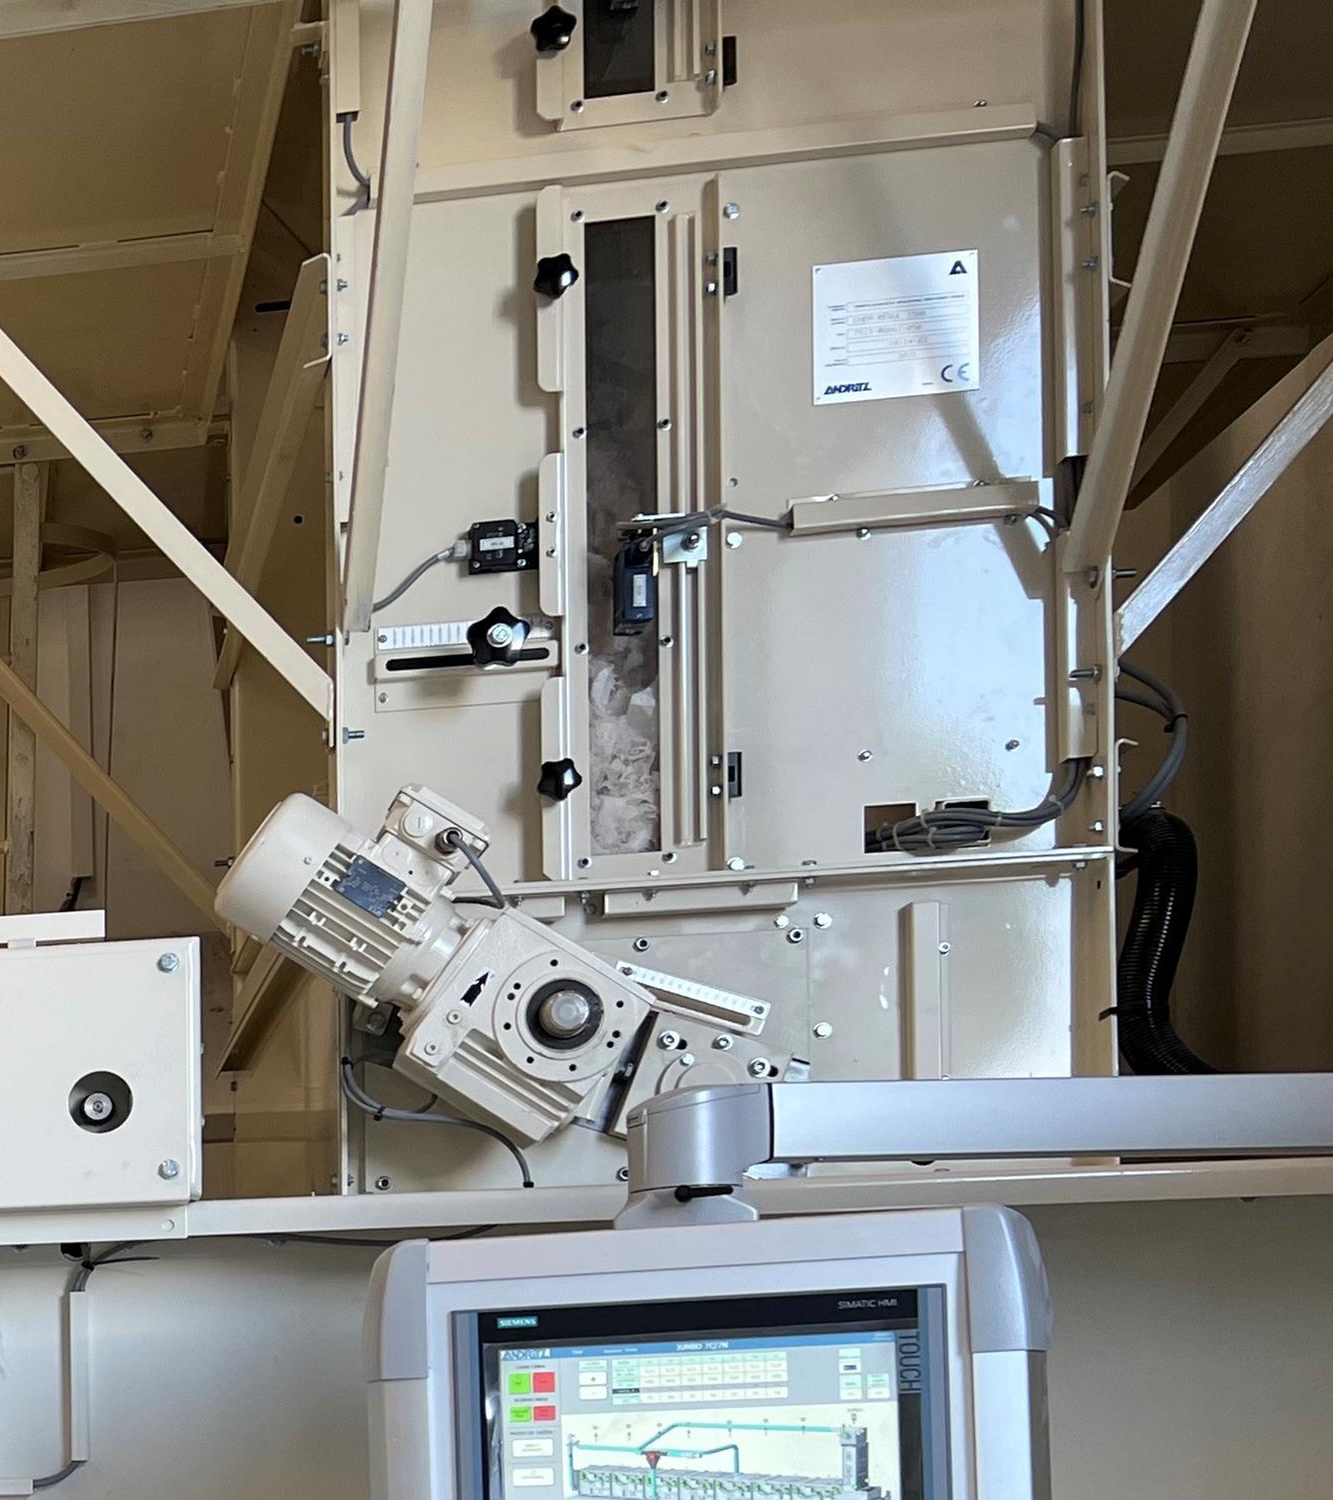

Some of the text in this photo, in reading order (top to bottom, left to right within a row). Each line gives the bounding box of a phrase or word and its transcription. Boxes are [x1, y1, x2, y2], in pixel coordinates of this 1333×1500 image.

[824, 382, 872, 395] ANDRITZ
[838, 1298, 898, 1310] SIMATIC HMI
[498, 1318, 537, 1327] SIEMENS
[898, 1332, 922, 1393] TOUCH
